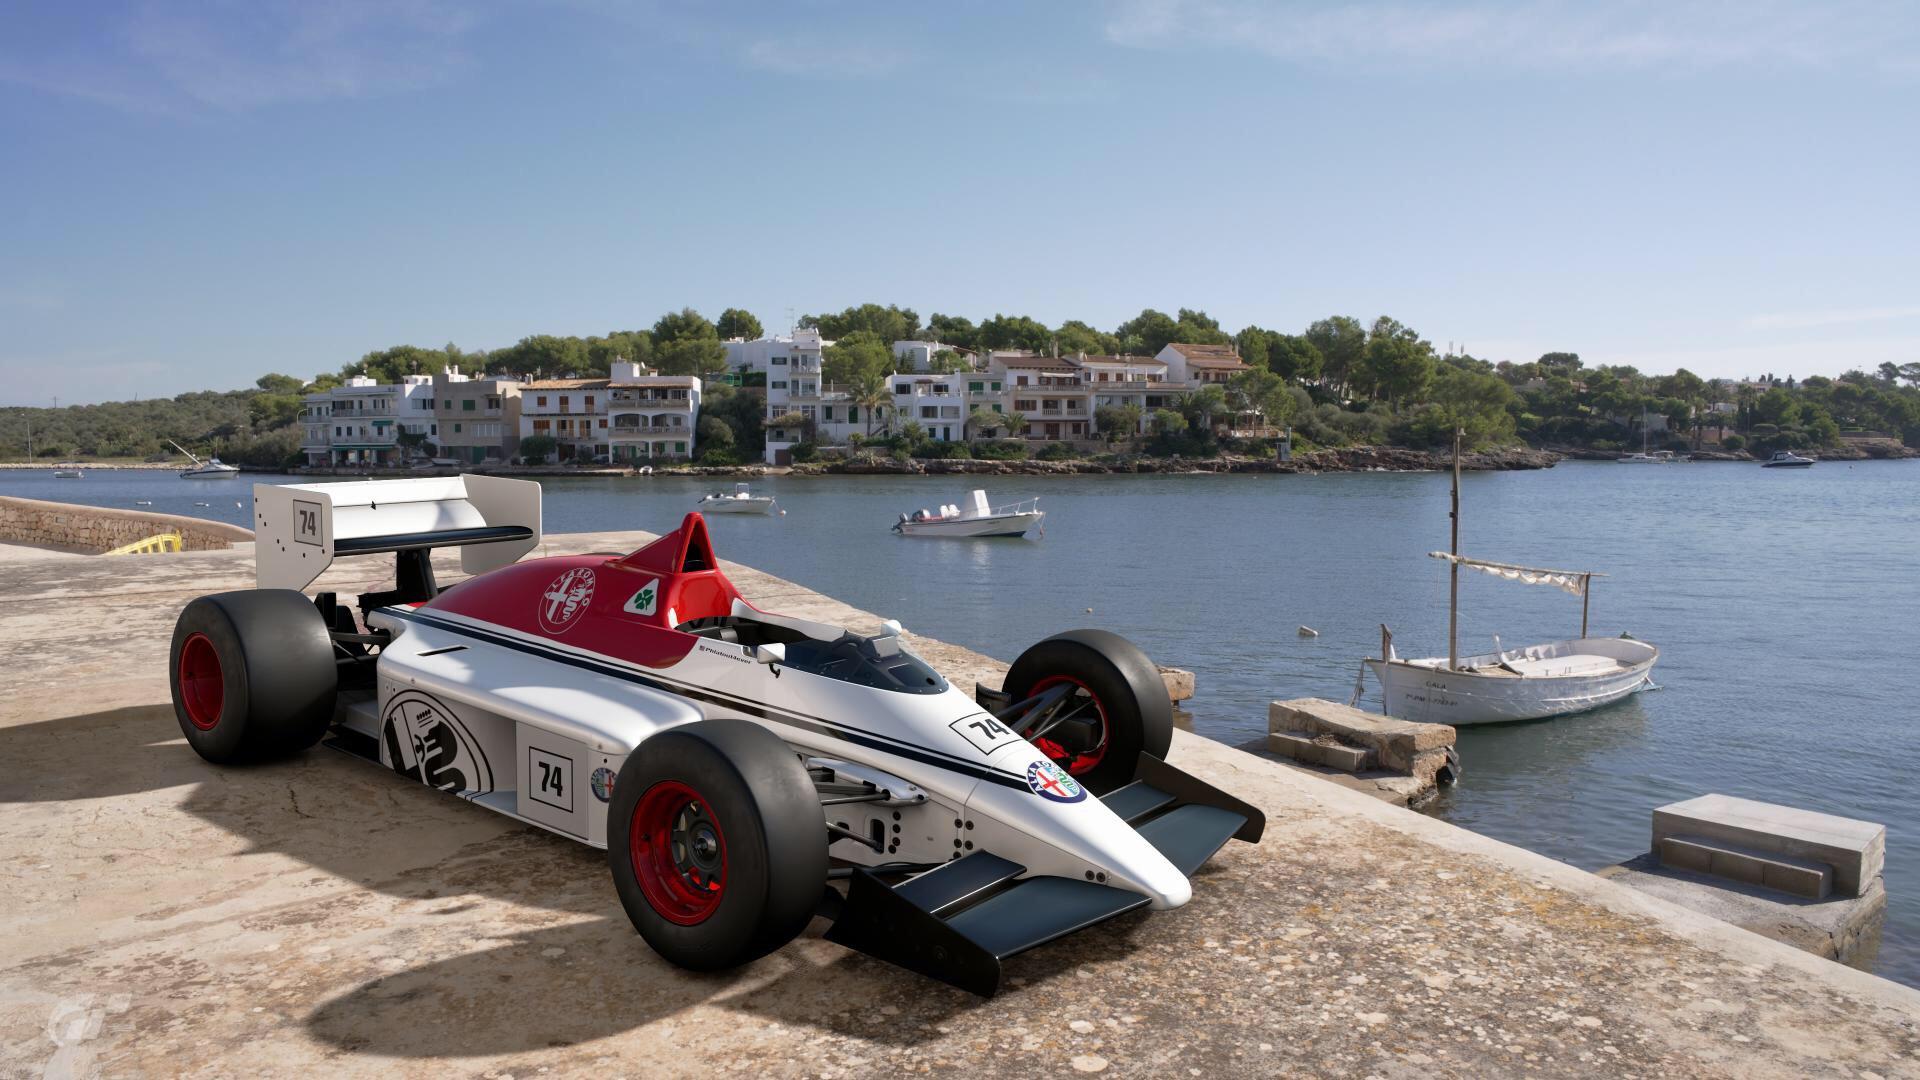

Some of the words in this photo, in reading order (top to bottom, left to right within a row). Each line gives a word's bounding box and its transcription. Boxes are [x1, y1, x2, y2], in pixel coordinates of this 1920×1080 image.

[300, 510, 316, 536] 74
[576, 568, 594, 607] ROMEO
[968, 718, 1010, 740] 74
[539, 761, 563, 797] 74
